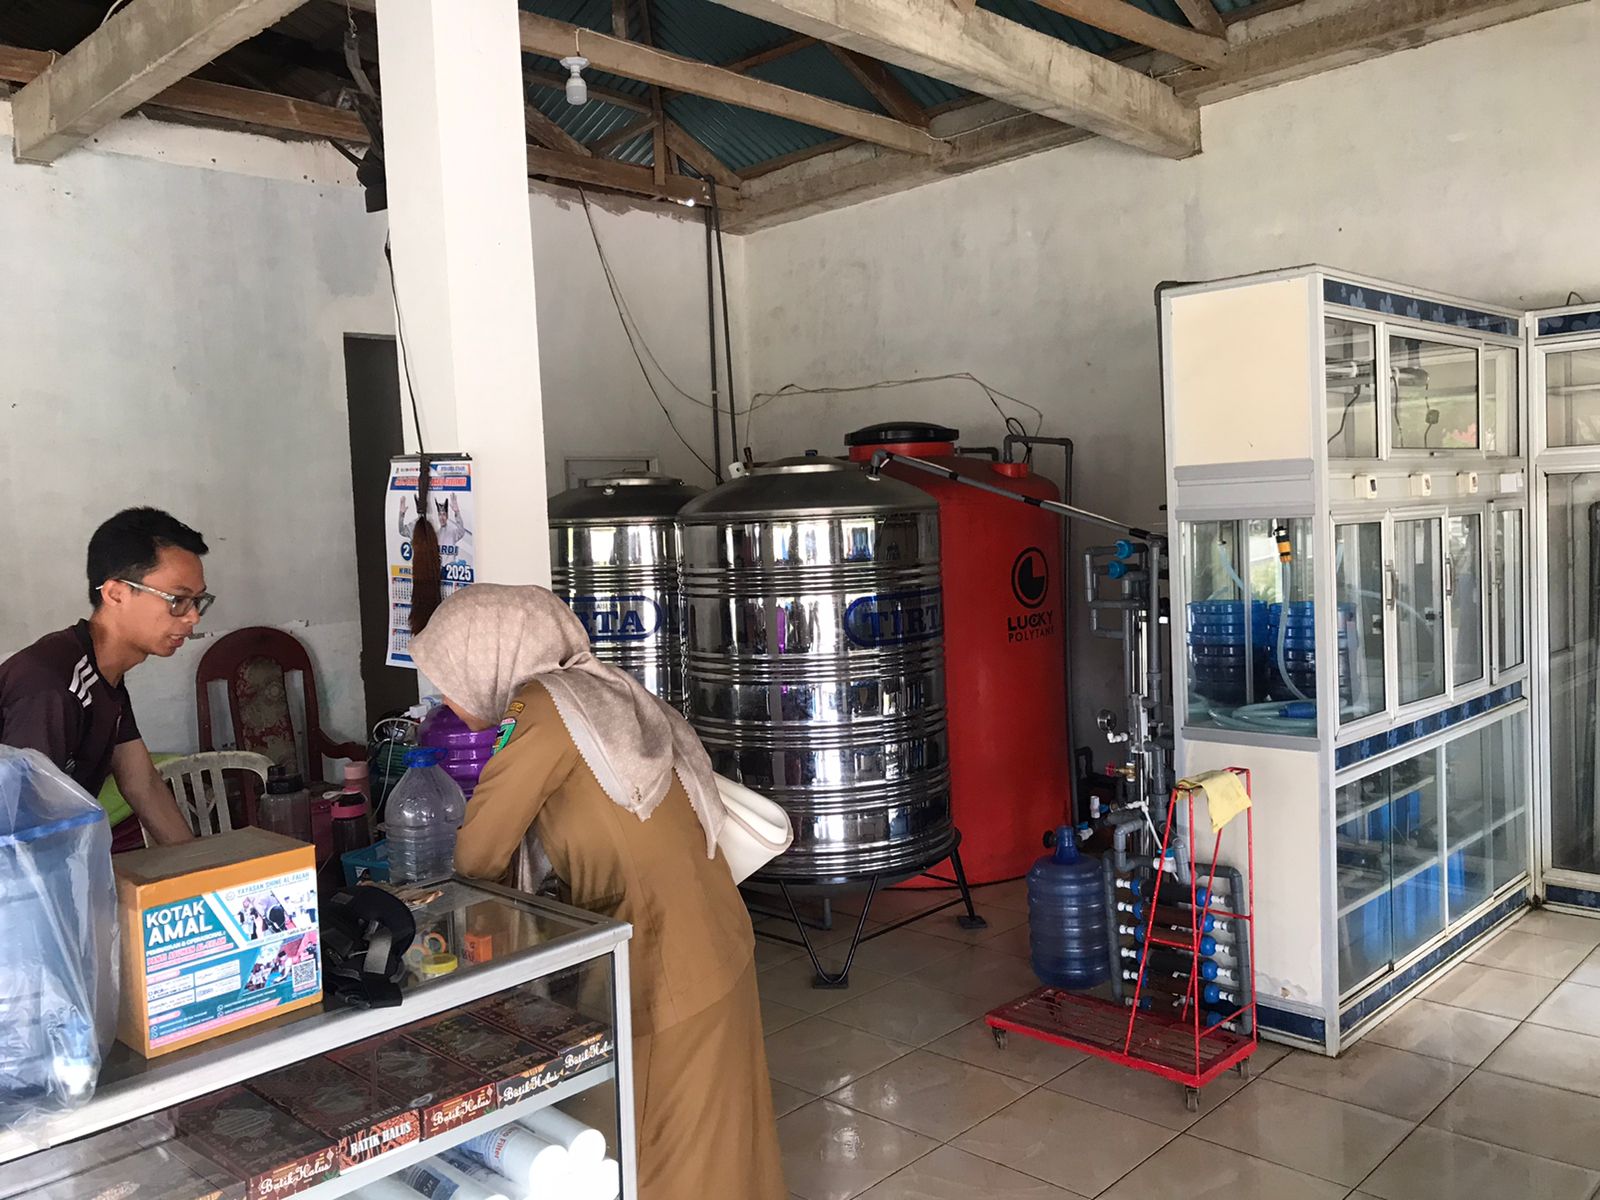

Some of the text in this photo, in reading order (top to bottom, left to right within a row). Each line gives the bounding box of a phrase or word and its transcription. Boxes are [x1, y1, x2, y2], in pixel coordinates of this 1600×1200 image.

[402, 544, 410, 557] 2
[438, 544, 459, 555] RDI
[446, 564, 471, 581] 2025
[1007, 610, 1053, 631] LUCKY
[146, 900, 206, 928] KOTAK
[148, 915, 213, 947] AMAL
[565, 1049, 591, 1069] Batik
[503, 1072, 560, 1101] Batik Halus
[432, 1096, 491, 1127] Batik Halus
[350, 1121, 412, 1156] BATIK HALUS
[260, 1160, 331, 1195] Batik Halus
